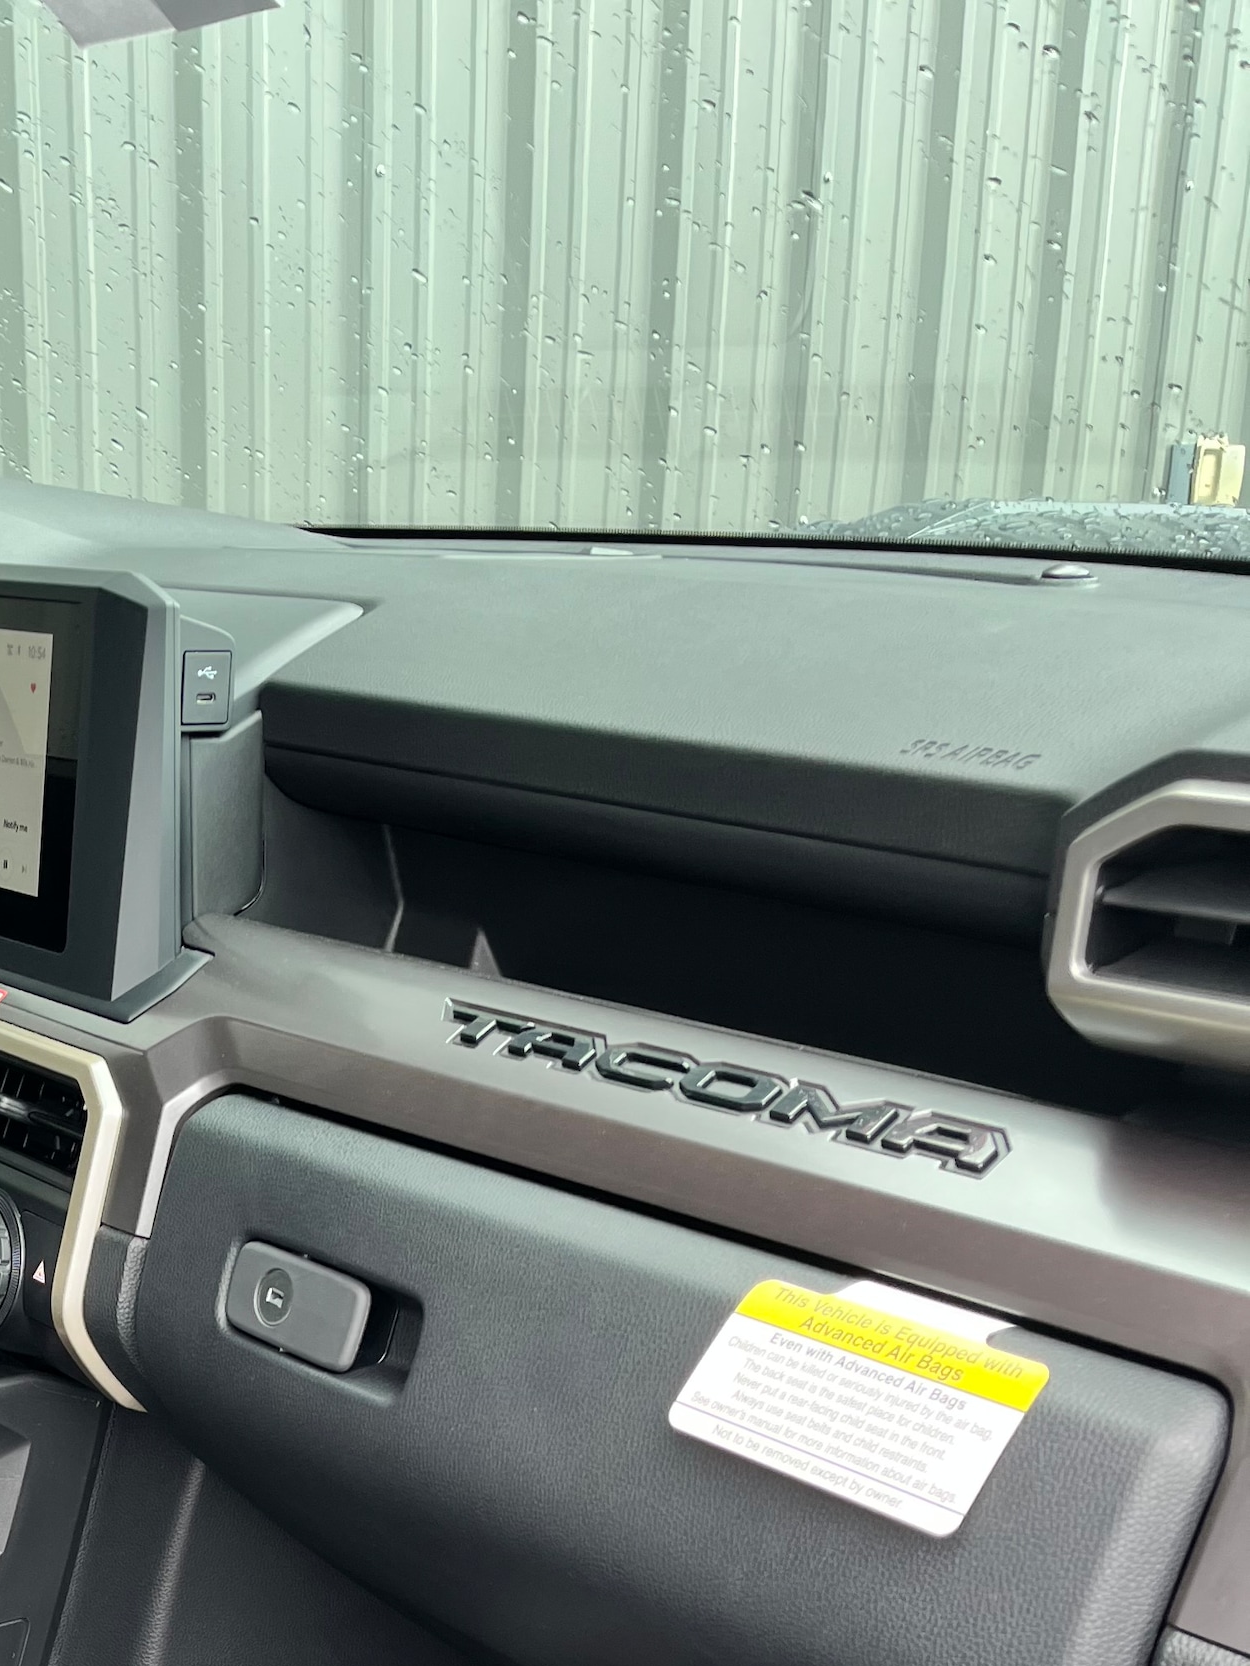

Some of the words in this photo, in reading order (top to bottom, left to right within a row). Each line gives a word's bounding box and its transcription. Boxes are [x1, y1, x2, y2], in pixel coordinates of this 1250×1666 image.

[28, 645, 46, 660] 10:54
[900, 739, 949, 758] SRS
[940, 744, 1041, 770] AIRBAG
[3, 819, 18, 832] Notify
[444, 1000, 1008, 1178] TACOMA
[769, 1332, 803, 1353] Even
[805, 1346, 834, 1364] with
[834, 1356, 905, 1388] Advanced
[903, 1380, 927, 1396] Air
[928, 1388, 968, 1411] Bags
[773, 1287, 811, 1308] This
[813, 1300, 873, 1329] Vehicle
[873, 1320, 893, 1335] is
[894, 1327, 982, 1364] Equipped
[981, 1355, 1025, 1379] with
[798, 1315, 888, 1354] Advanced
[884, 1344, 915, 1364] Air
[915, 1354, 967, 1381] Bags
[728, 1335, 767, 1357] Children
[766, 1351, 786, 1364] can
[785, 1356, 800, 1369] be
[826, 1373, 839, 1383] or
[838, 1377, 884, 1401] seriously
[884, 1392, 921, 1413] injured
[919, 1404, 935, 1420] by
[935, 1411, 953, 1425] the
[953, 1418, 970, 1431] air
[969, 1422, 993, 1442] bag.
[730, 1389, 765, 1410] Always
[765, 1404, 784, 1417] use
[784, 1411, 808, 1426] seat
[806, 1417, 832, 1436] belts
[832, 1429, 854, 1444] and
[852, 1437, 880, 1454] child
[878, 1447, 928, 1473] restraints.
[732, 1371, 762, 1390] Never
[760, 1385, 780, 1397] put
[778, 1391, 787, 1401] a
[787, 1394, 840, 1422] rear-facing
[839, 1414, 866, 1429] child
[864, 1423, 889, 1439] seat
[888, 1430, 900, 1443] in
[900, 1435, 919, 1450] the
[919, 1441, 946, 1461] front.
[743, 1357, 762, 1373] The
[761, 1366, 786, 1382] back
[785, 1376, 809, 1390] seat
[807, 1382, 818, 1394] is
[818, 1386, 835, 1400] the
[865, 1405, 895, 1422] place
[912, 1422, 955, 1445] children.
[690, 1390, 711, 1406] See
[711, 1400, 747, 1421] owner's
[747, 1414, 784, 1434] manual
[797, 1434, 824, 1450] more
[880, 1466, 913, 1485] about
[912, 1478, 929, 1491] air
[928, 1481, 962, 1504] bags.
[710, 1423, 734, 1440] Not
[731, 1432, 747, 1445] to
[743, 1437, 763, 1452] be
[759, 1443, 811, 1471] removed
[807, 1463, 850, 1489] except
[847, 1478, 865, 1495] by
[863, 1486, 904, 1509] owner.
